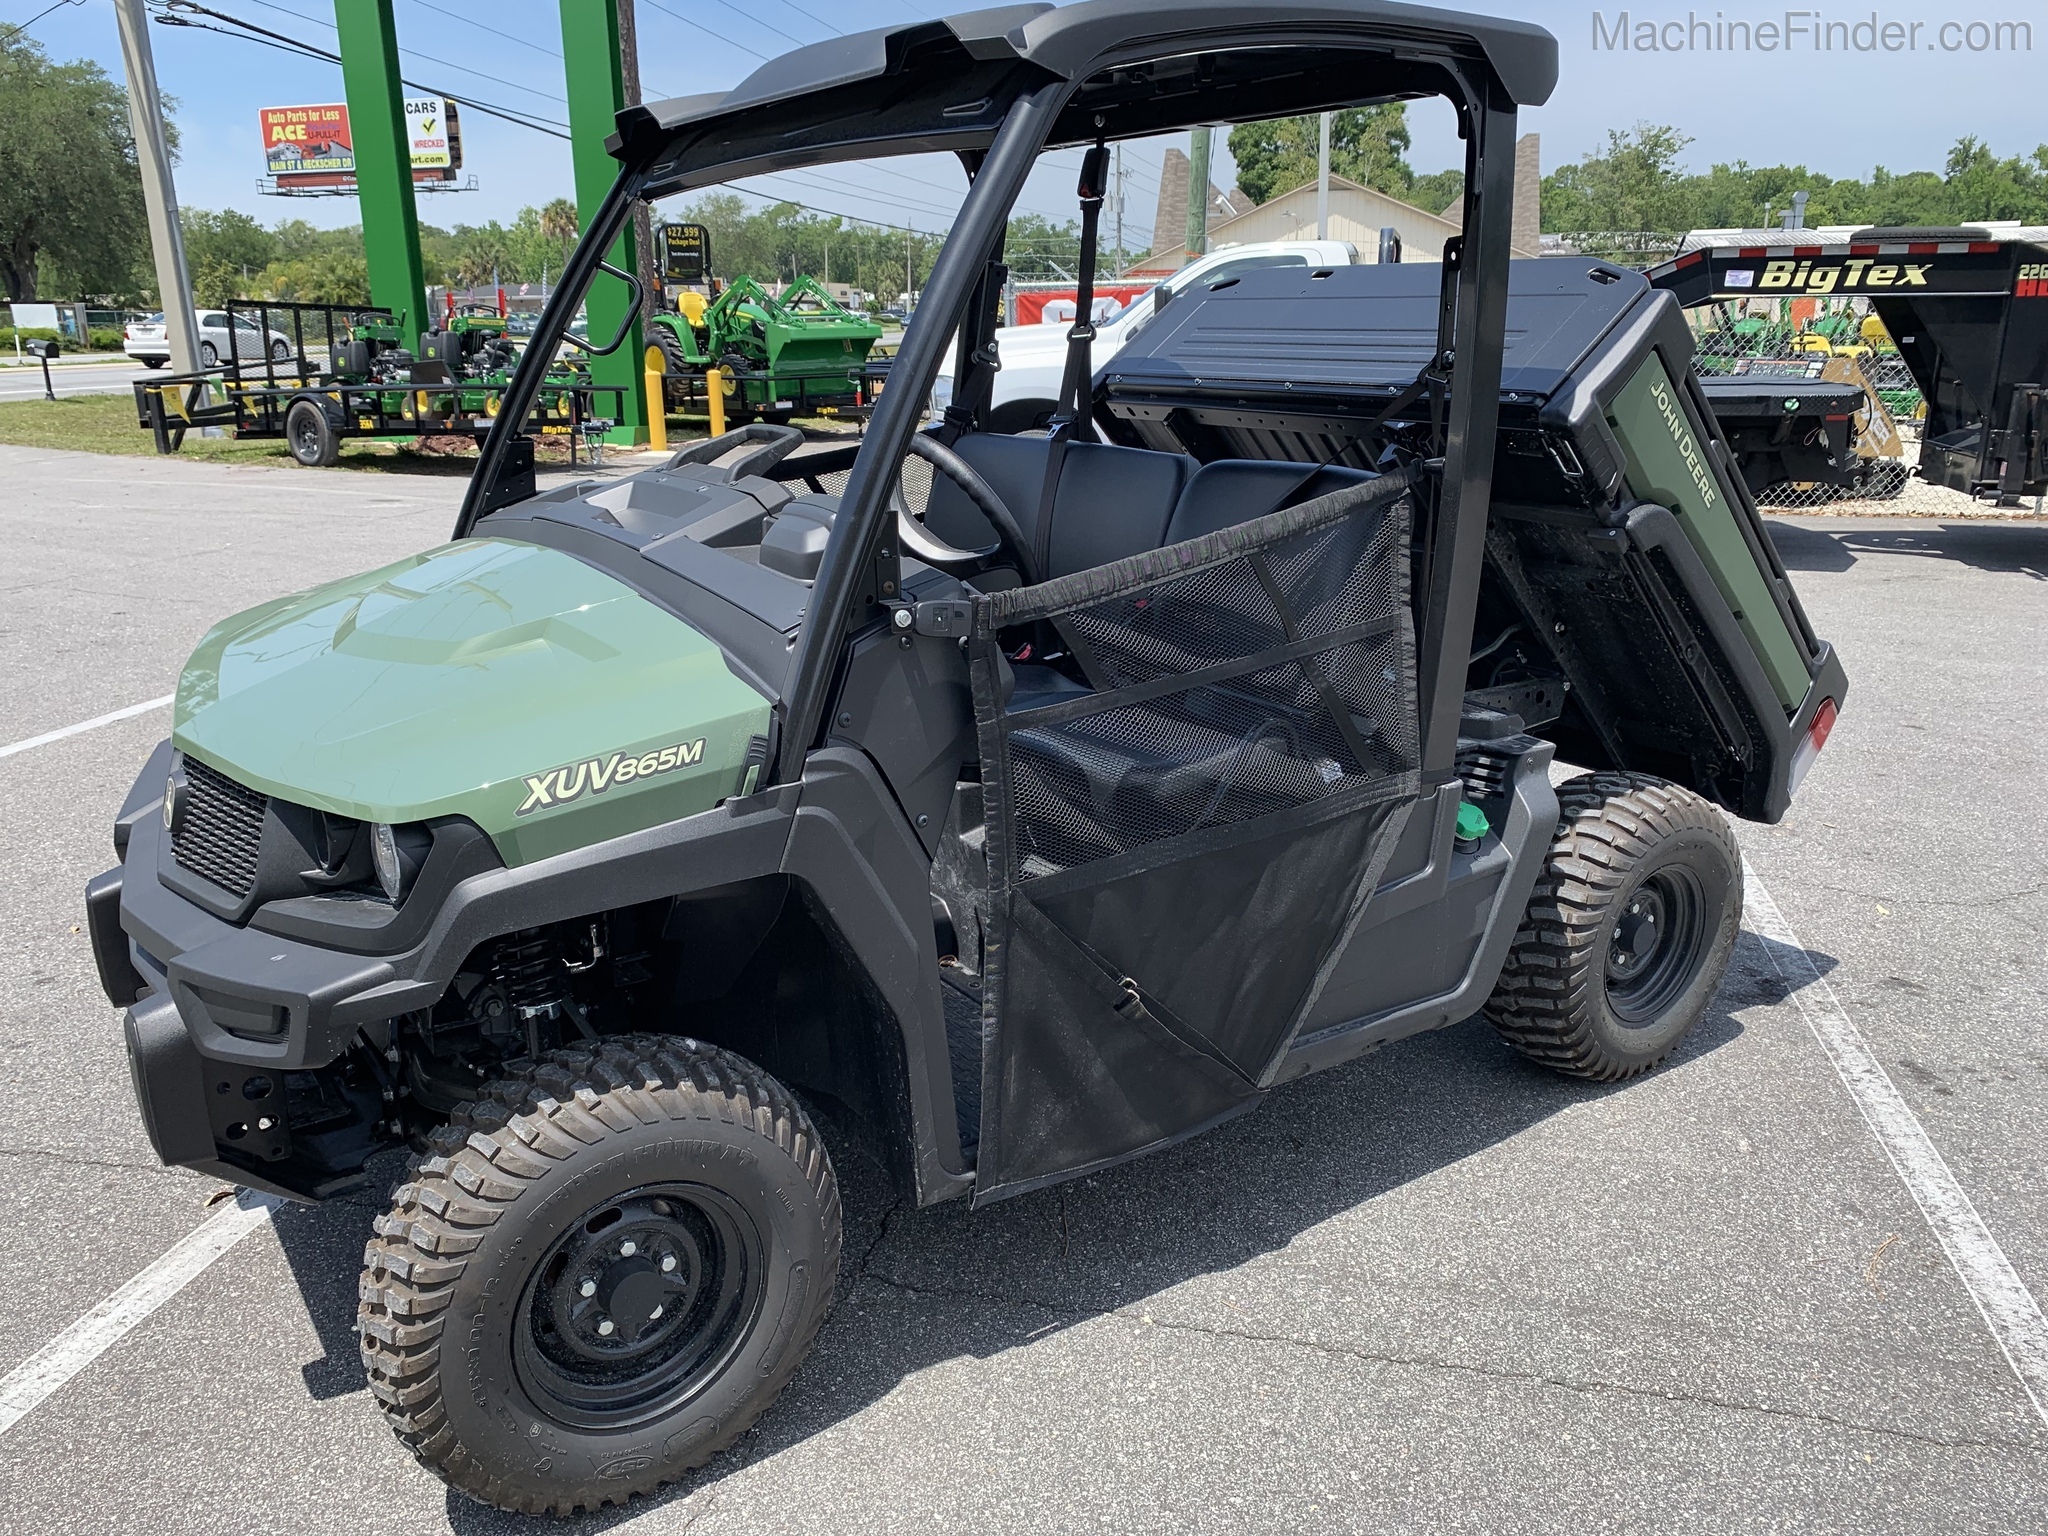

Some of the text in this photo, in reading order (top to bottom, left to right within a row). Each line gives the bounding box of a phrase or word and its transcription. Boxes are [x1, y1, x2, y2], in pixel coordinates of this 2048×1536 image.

[405, 101, 437, 114] CARS
[268, 108, 340, 124] Auto Parts for Less
[271, 124, 308, 141] ACE
[308, 130, 341, 139] U-PULL-IT
[413, 138, 445, 149] WRECKED
[269, 157, 353, 171] MAIN ST & HECKSCHER DR
[667, 226, 699, 238] $27,999
[668, 238, 689, 247] Package
[1758, 258, 1934, 294] BigTex
[542, 425, 573, 435] BigTex
[1649, 378, 1716, 509] JOHN DEERE
